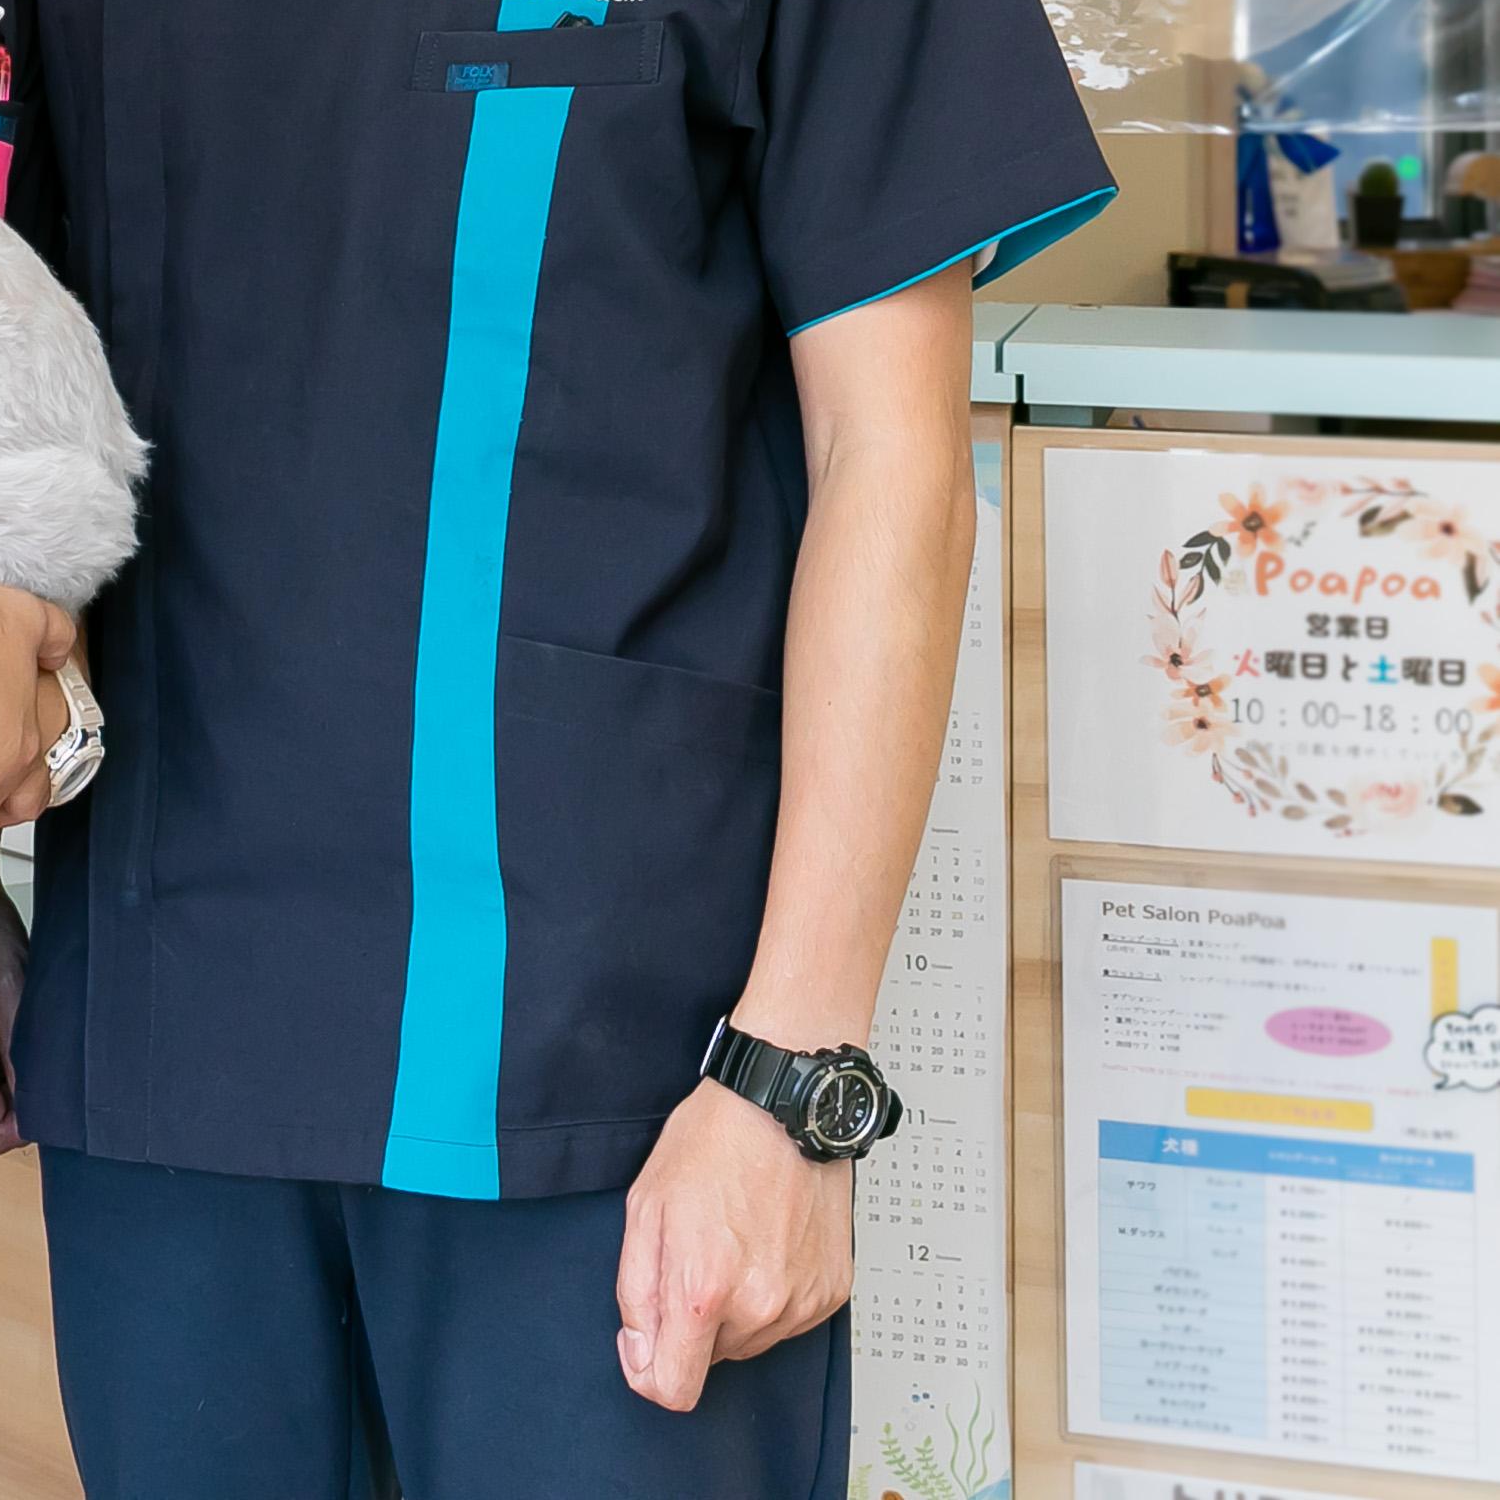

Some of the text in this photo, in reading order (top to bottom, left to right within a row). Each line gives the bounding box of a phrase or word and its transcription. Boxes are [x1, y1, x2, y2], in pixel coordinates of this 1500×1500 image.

[1306, 613, 1390, 641] 営業日
[1234, 647, 1468, 688] 火曜日と土曜日
[931, 892, 941, 900] 15
[952, 893, 963, 901] 16
[909, 908, 941, 918] 21 22
[1102, 901, 1287, 931] Pet Salon PoaPoa
[930, 928, 942, 936] 29
[905, 954, 928, 971] 10
[912, 1027, 921, 1036] 12
[933, 1028, 943, 1037] 13
[954, 1030, 964, 1038] 14
[912, 1045, 922, 1053] 19
[931, 1047, 943, 1055] 20
[911, 1063, 922, 1071] 26
[932, 1065, 943, 1073] 27
[953, 1067, 964, 1075] 28
[906, 1108, 925, 1125] 11
[1162, 1137, 1199, 1157] 犬種
[869, 1178, 879, 1186] 14
[890, 1180, 900, 1188] 15
[912, 1181, 922, 1189] 16
[933, 1183, 944, 1191] 17
[890, 1197, 900, 1205] 22
[932, 1201, 944, 1209] 24
[908, 1244, 929, 1261] 12
[872, 1313, 881, 1322] 12
[893, 1315, 903, 1323] 13
[914, 1317, 925, 1325] 14
[892, 1333, 904, 1341] 20
[914, 1335, 924, 1343] 21
[871, 1348, 882, 1357] 26
[892, 1350, 904, 1358] 27
[935, 1355, 946, 1364] 29
